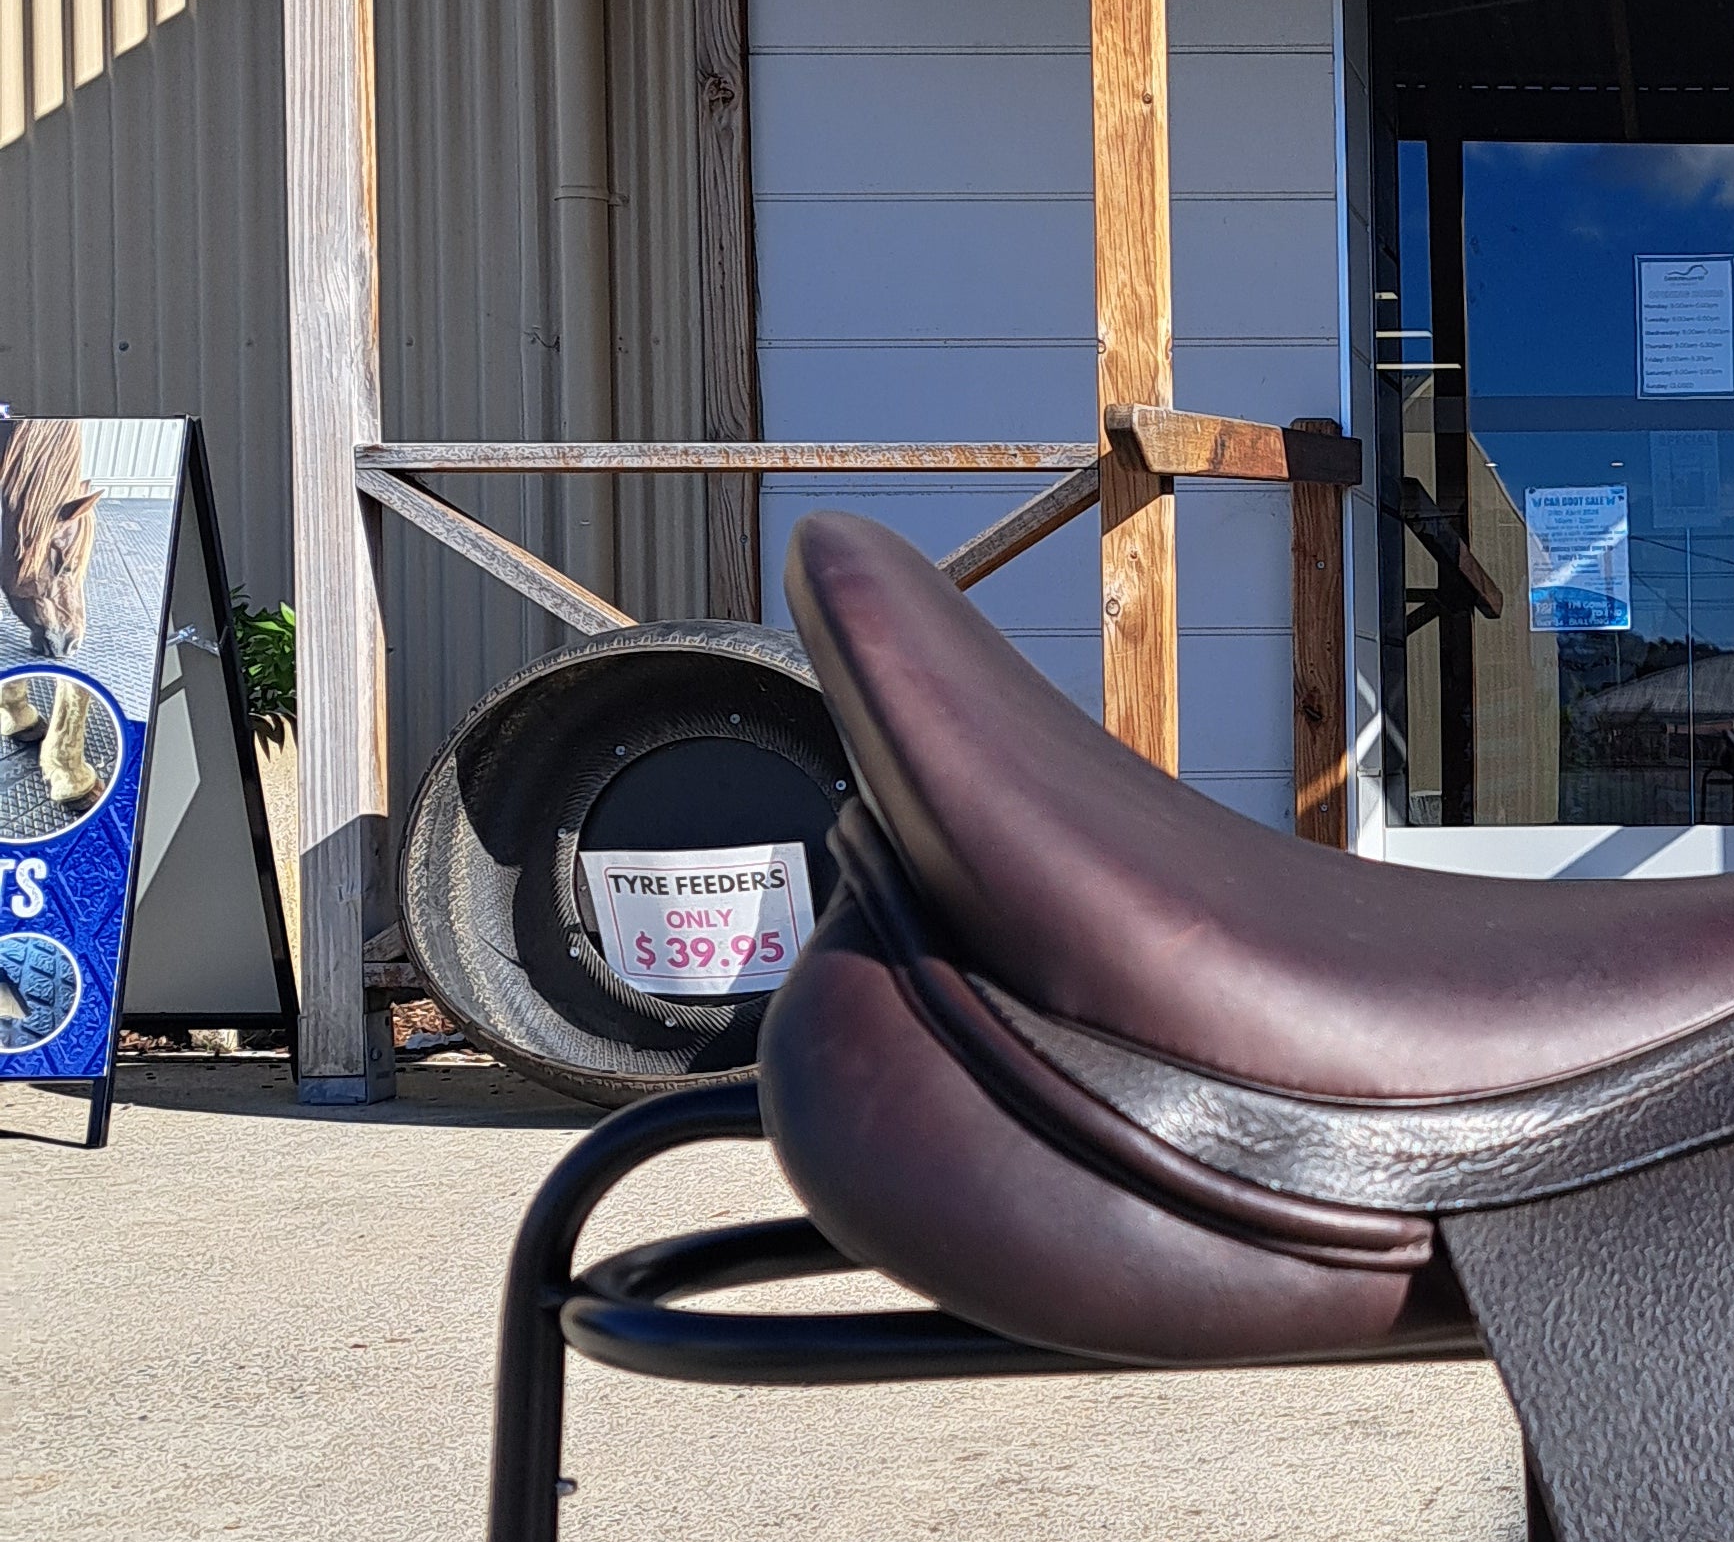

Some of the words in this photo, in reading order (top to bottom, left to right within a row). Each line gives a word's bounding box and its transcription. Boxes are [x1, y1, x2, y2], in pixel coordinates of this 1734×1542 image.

[608, 874, 670, 896] TYRE
[675, 868, 786, 896] FEEDERS
[665, 908, 733, 929] ONLY
